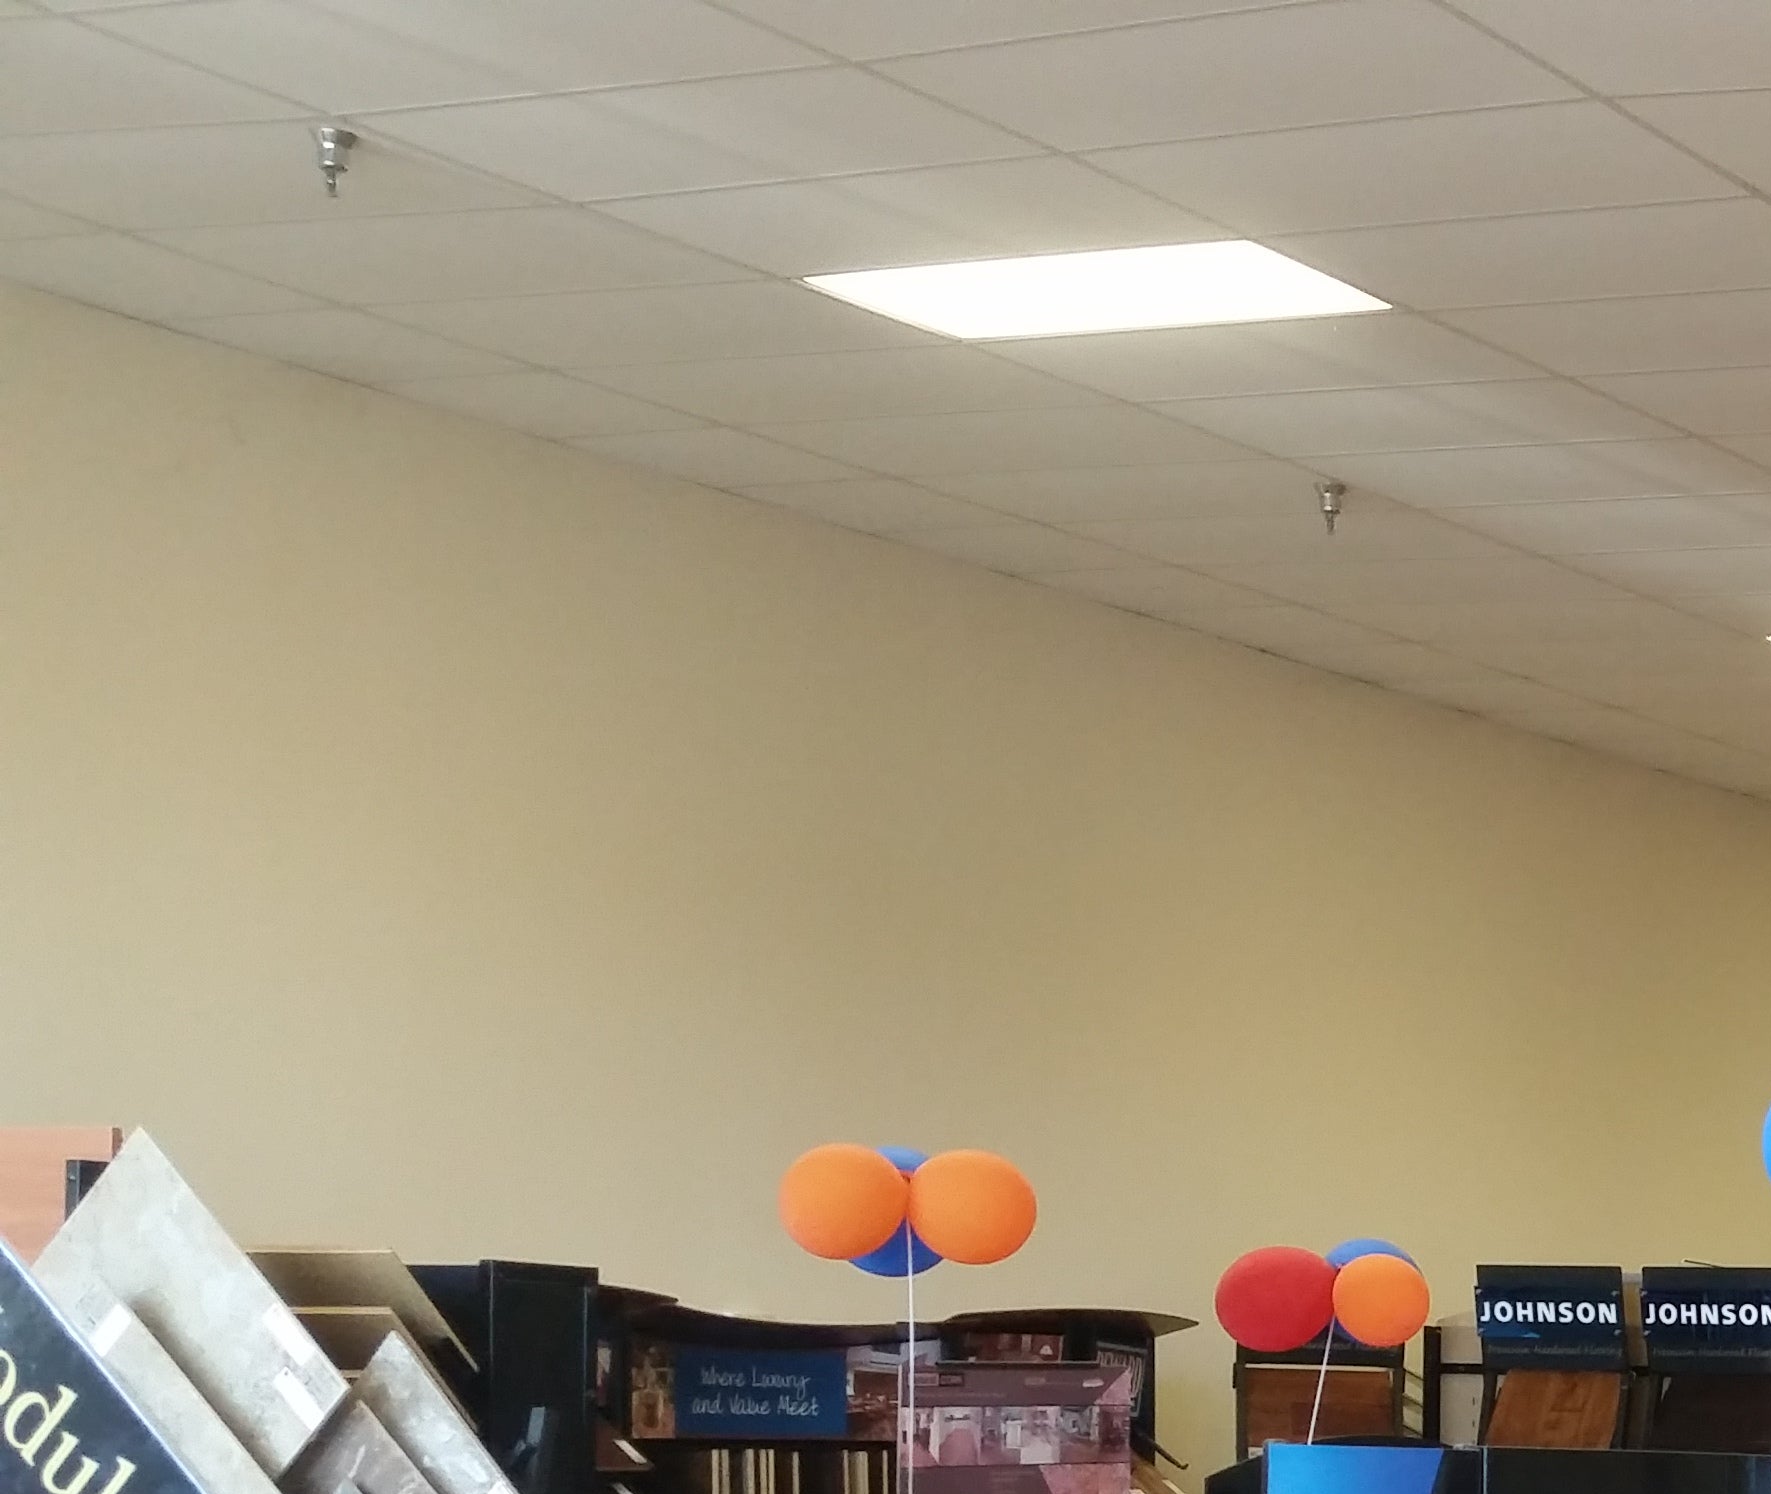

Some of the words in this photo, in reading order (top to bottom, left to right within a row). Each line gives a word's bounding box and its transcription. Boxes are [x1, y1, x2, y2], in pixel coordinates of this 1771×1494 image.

[1480, 1300, 1617, 1324] JOHNSON
[701, 1366, 746, 1387] Where
[692, 1393, 724, 1415] and
[730, 1397, 771, 1415] Value
[777, 1393, 820, 1417] Meet
